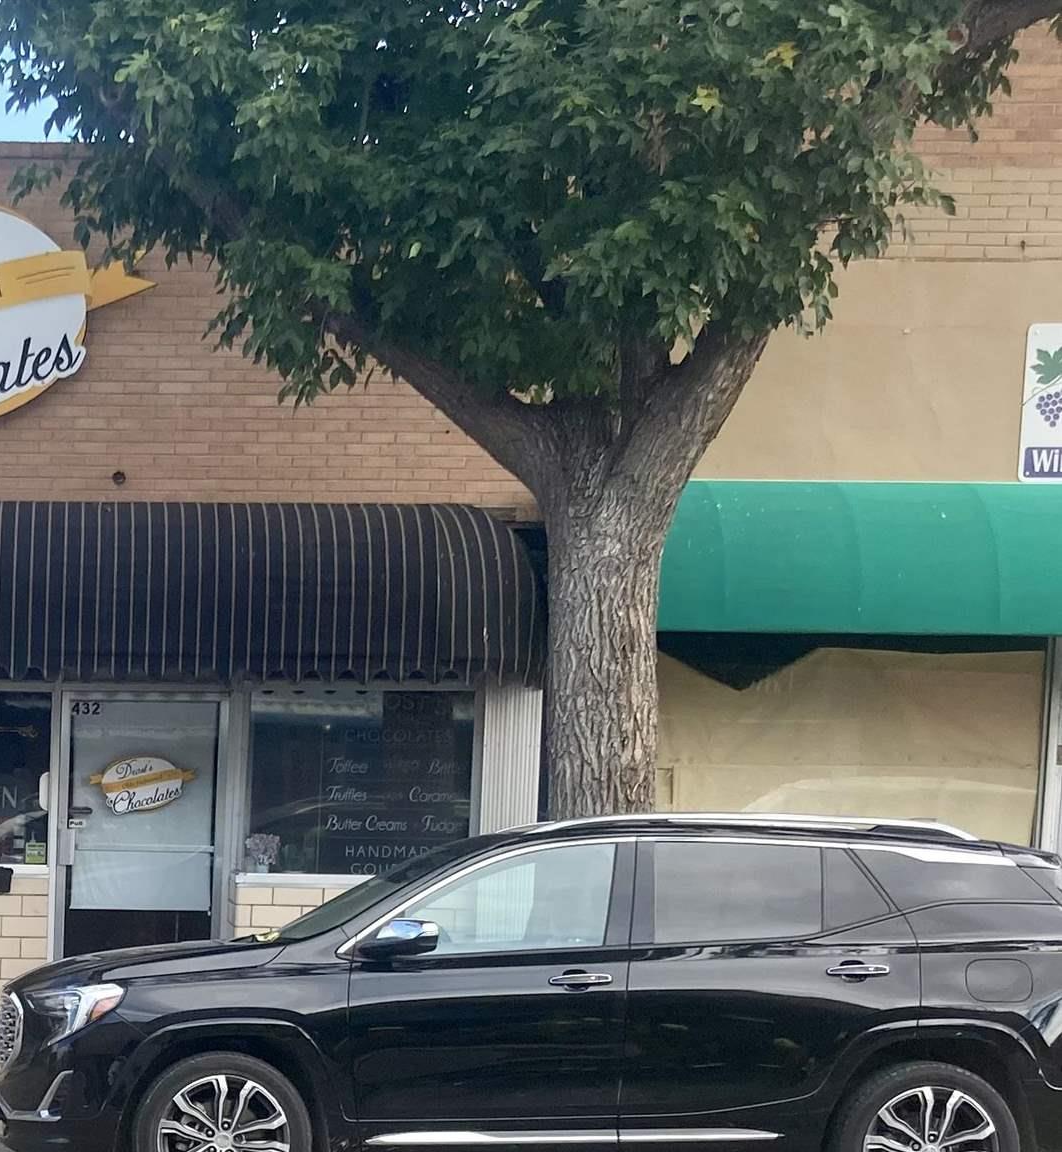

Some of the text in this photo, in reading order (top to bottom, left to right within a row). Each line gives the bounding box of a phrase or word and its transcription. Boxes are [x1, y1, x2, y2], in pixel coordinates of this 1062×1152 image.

[1032, 449, 1062, 473] Wi
[71, 702, 100, 715] 432
[108, 788, 180, 814] Chocolates
[345, 845, 430, 858] HANDMAD
